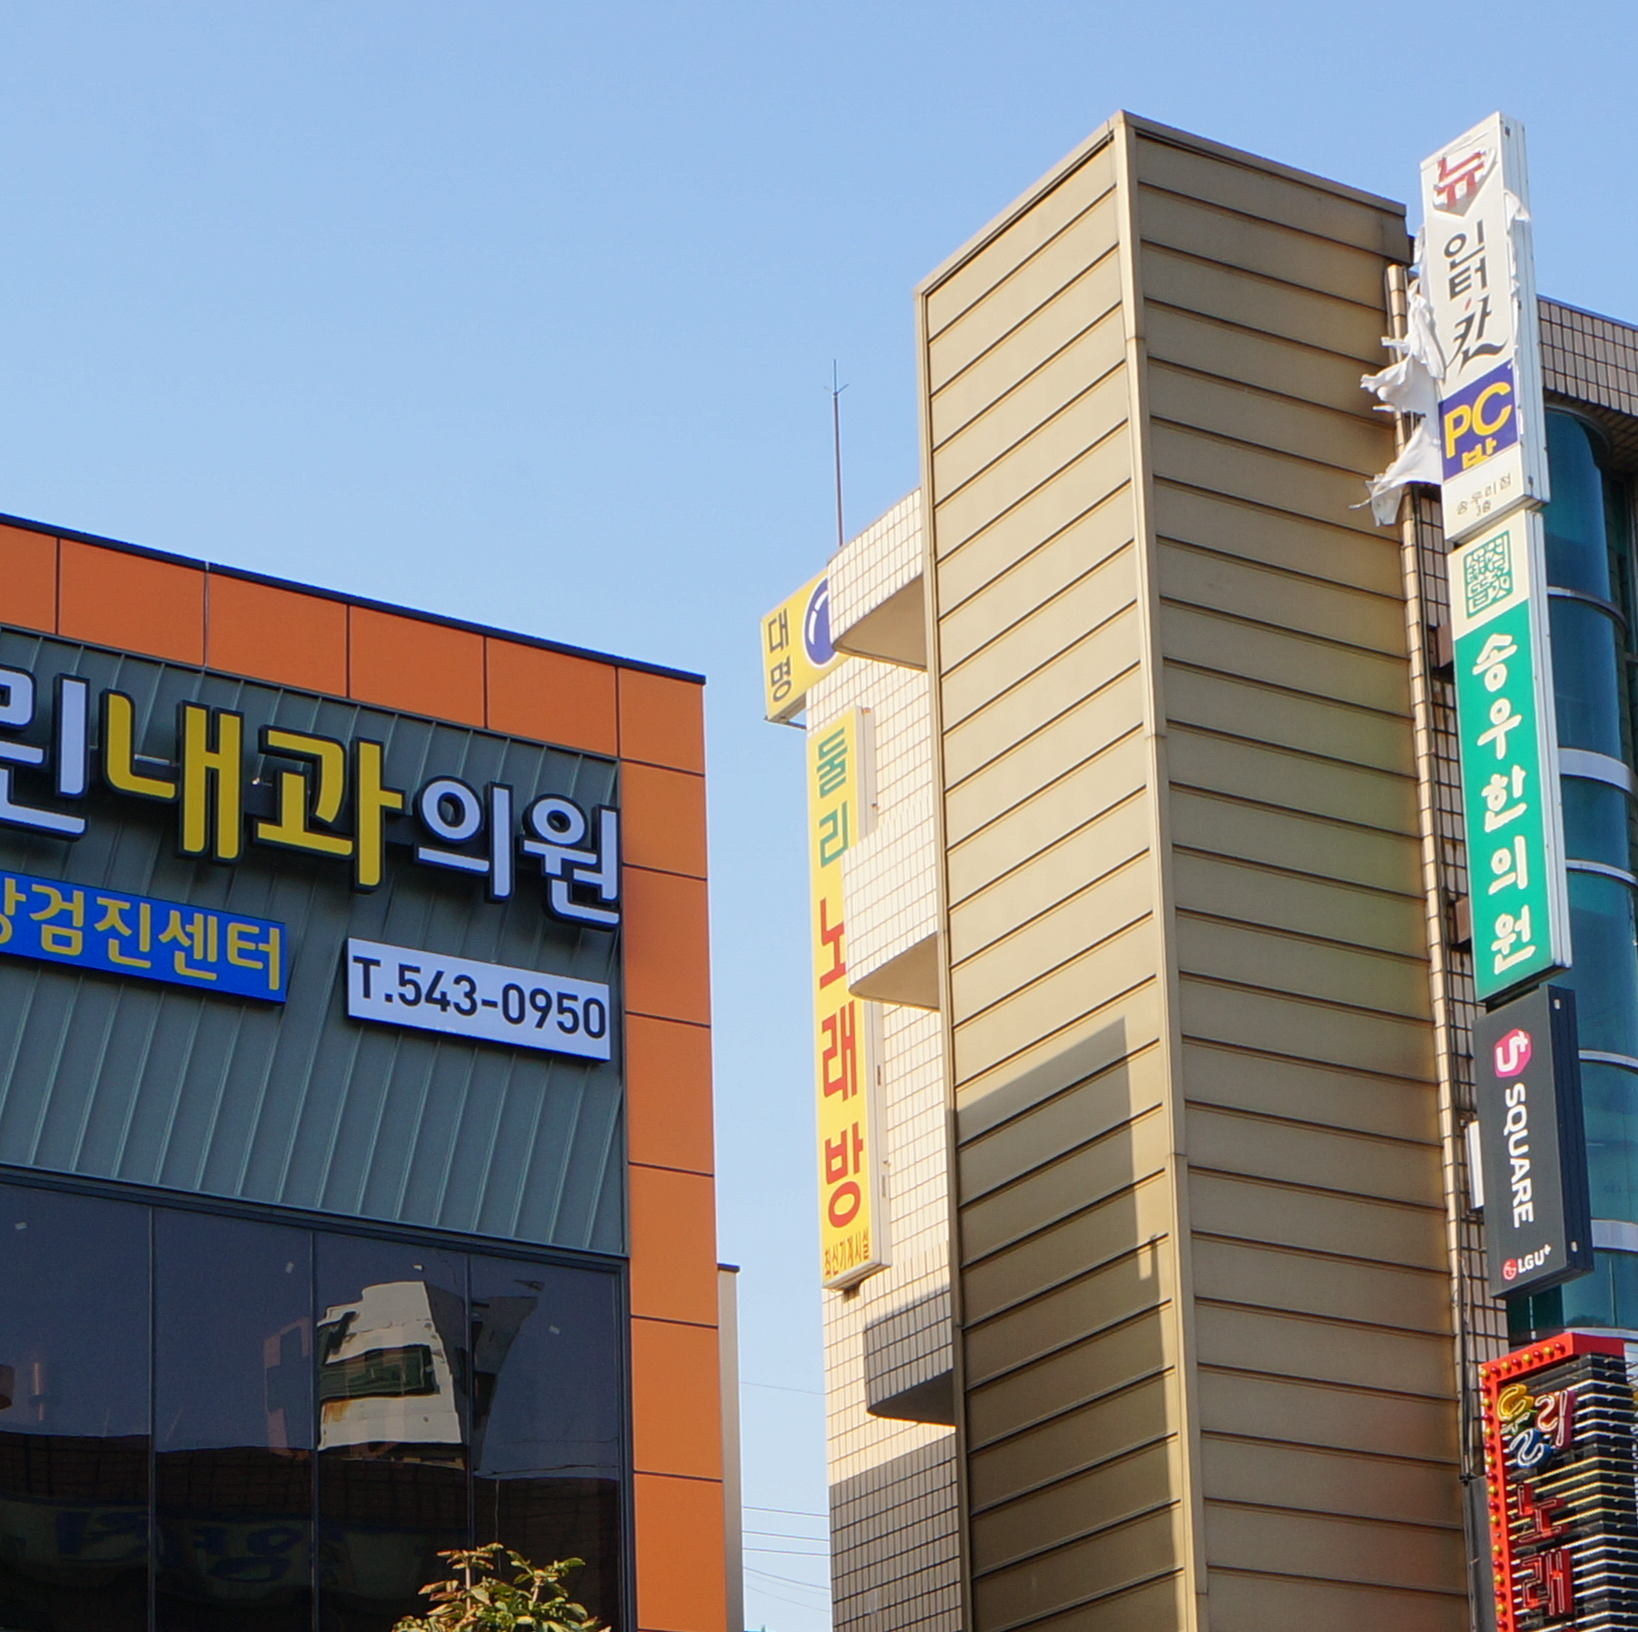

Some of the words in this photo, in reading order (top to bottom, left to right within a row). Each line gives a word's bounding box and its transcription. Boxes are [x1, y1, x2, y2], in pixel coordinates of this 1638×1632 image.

[1443, 380, 1512, 460] PC
[768, 608, 791, 702] 대명
[816, 727, 848, 868] 둘리
[1472, 632, 1535, 976] 송우한의원
[352, 954, 608, 1041] T.543-0950
[818, 897, 864, 1229] 노래방
[1504, 1083, 1536, 1229] SQUARE
